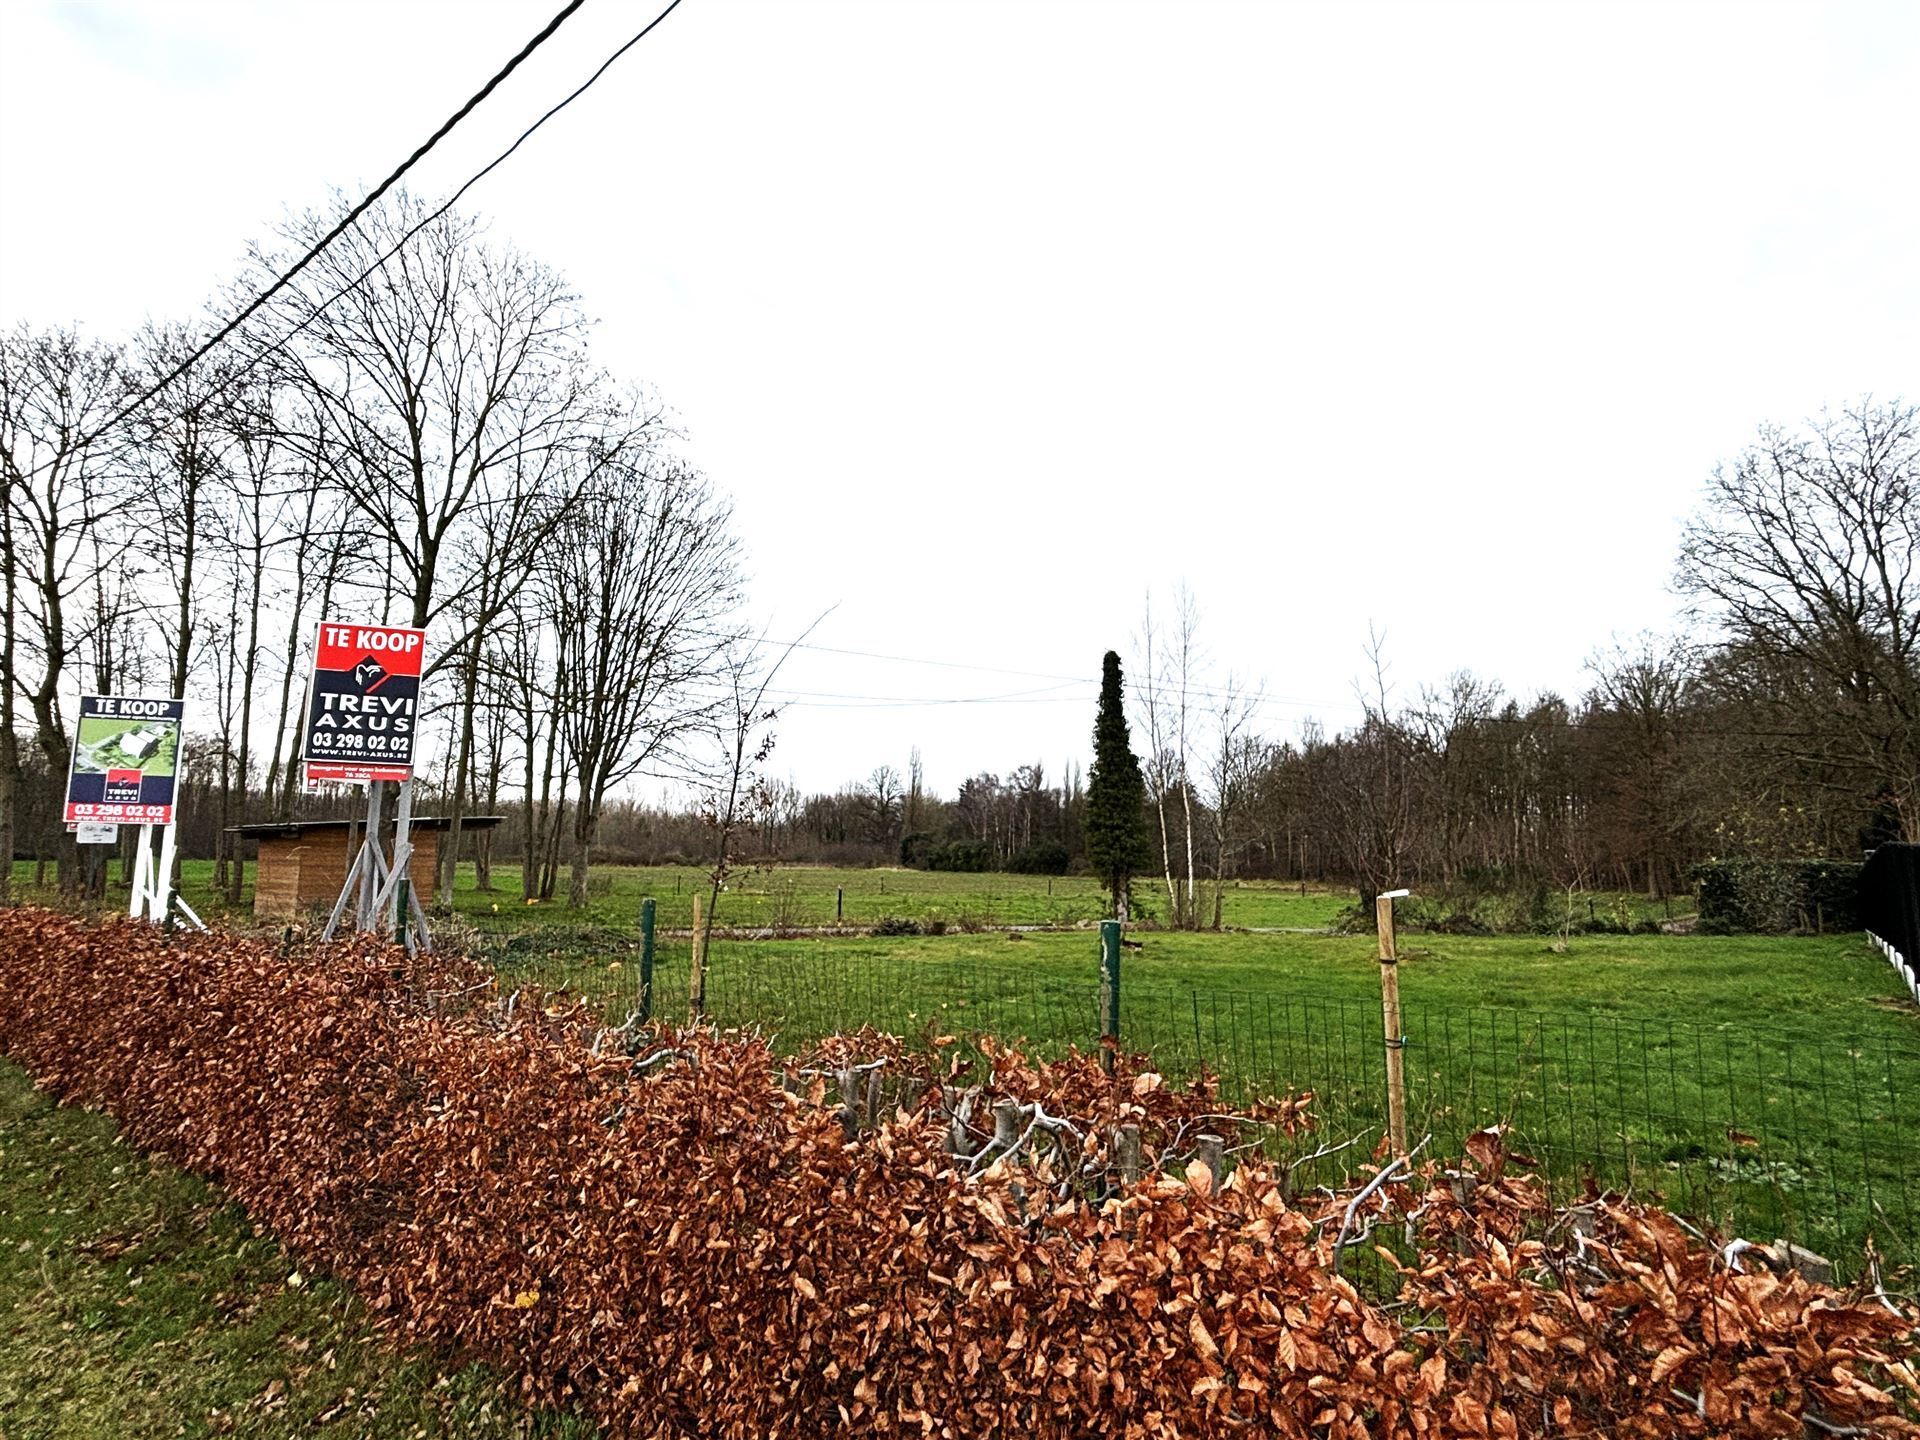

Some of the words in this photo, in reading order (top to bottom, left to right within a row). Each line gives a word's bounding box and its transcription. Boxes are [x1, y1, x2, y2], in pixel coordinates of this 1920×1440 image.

[326, 628, 350, 648] TE
[356, 630, 419, 653] KOOP
[96, 699, 116, 713] TE
[120, 700, 170, 716] KOOP
[319, 693, 414, 716] TREVI
[315, 713, 410, 732] AXUS
[312, 732, 332, 747] 03
[335, 733, 364, 749] 298
[367, 735, 386, 750] 02
[390, 736, 409, 751] 02
[311, 748, 408, 759] WWW.TREVI-AXUS.BE
[107, 788, 138, 796] TREVI
[74, 804, 94, 815] 03
[95, 804, 123, 816] 298
[125, 805, 144, 816] 02
[146, 806, 165, 817] 02
